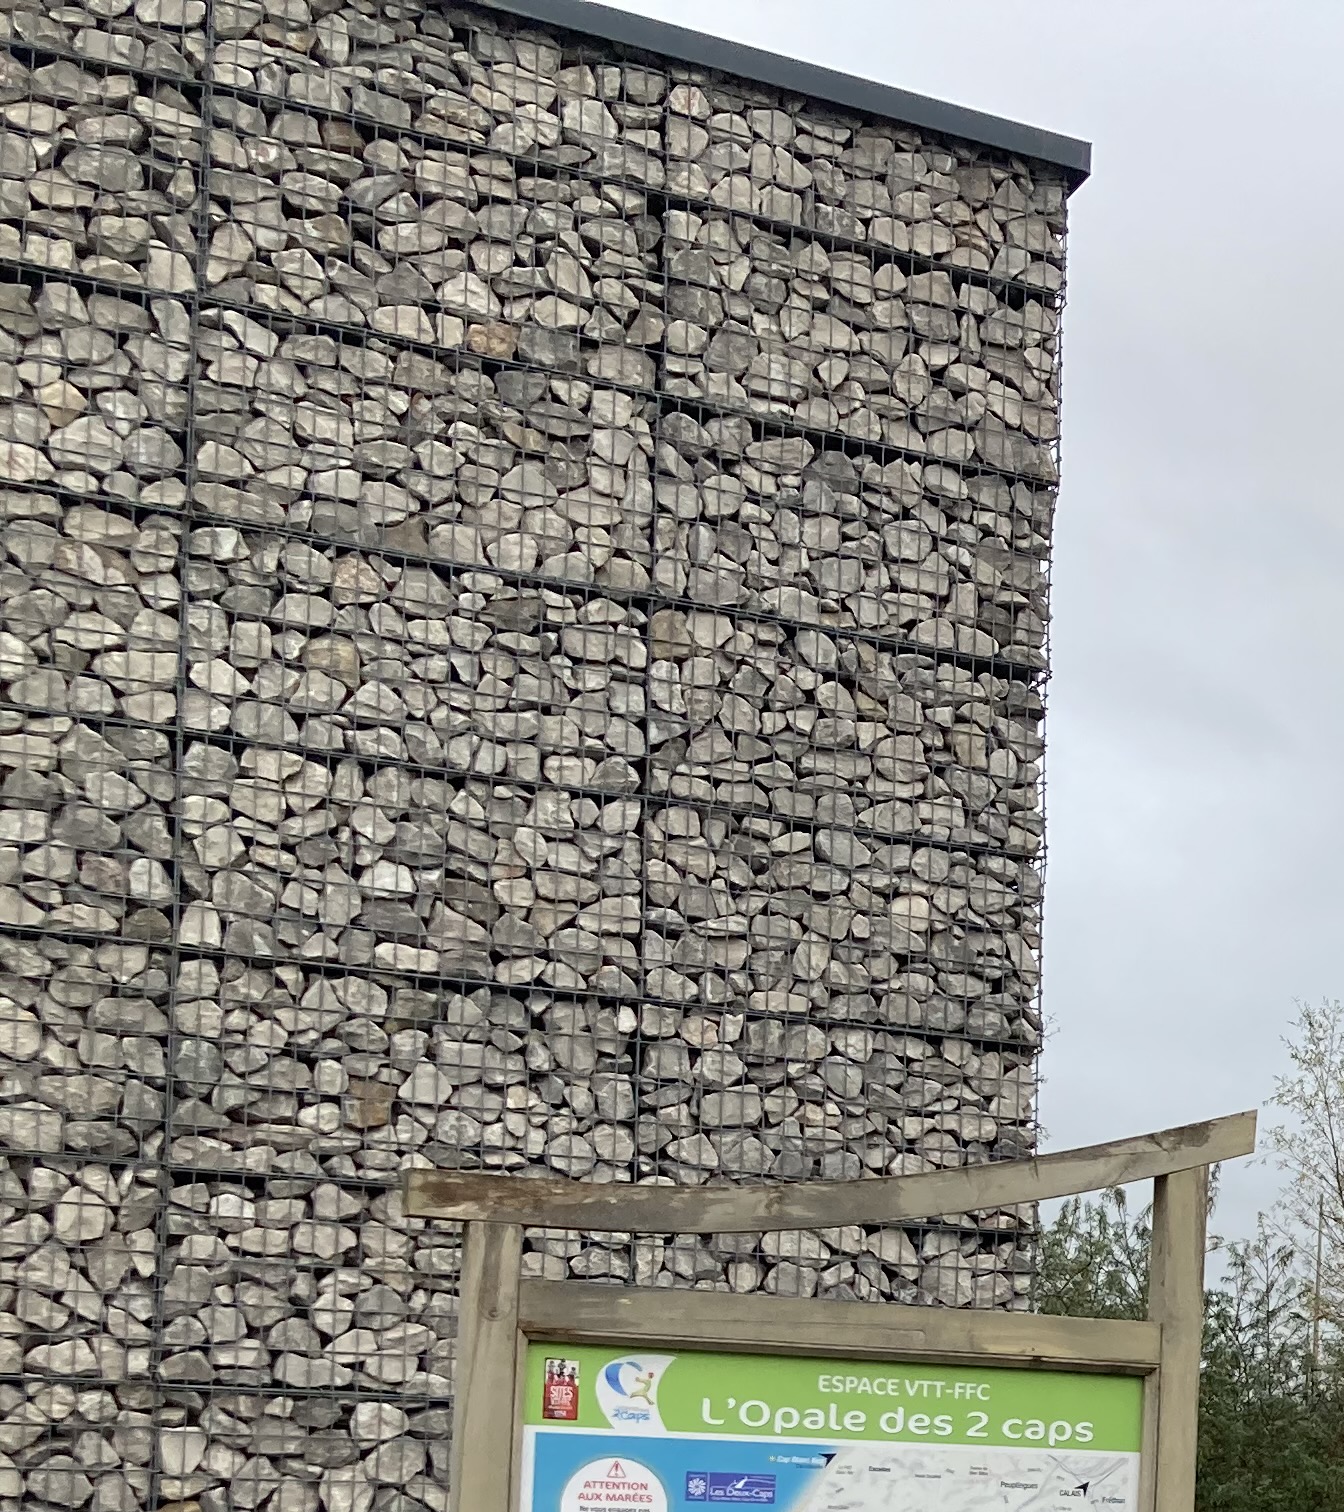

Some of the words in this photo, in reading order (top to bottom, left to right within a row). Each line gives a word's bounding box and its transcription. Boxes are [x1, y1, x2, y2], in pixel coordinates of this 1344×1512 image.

[818, 1374, 899, 1396] ESPACE
[904, 1379, 991, 1401] VTT-FFC
[702, 1397, 867, 1434] L'Opale
[879, 1406, 954, 1437] des
[966, 1411, 990, 1438] 2
[1001, 1417, 1095, 1447] caps
[583, 1480, 648, 1491] ATTENTION
[578, 1492, 603, 1502] AUX
[605, 1492, 653, 1503] MARÉES
